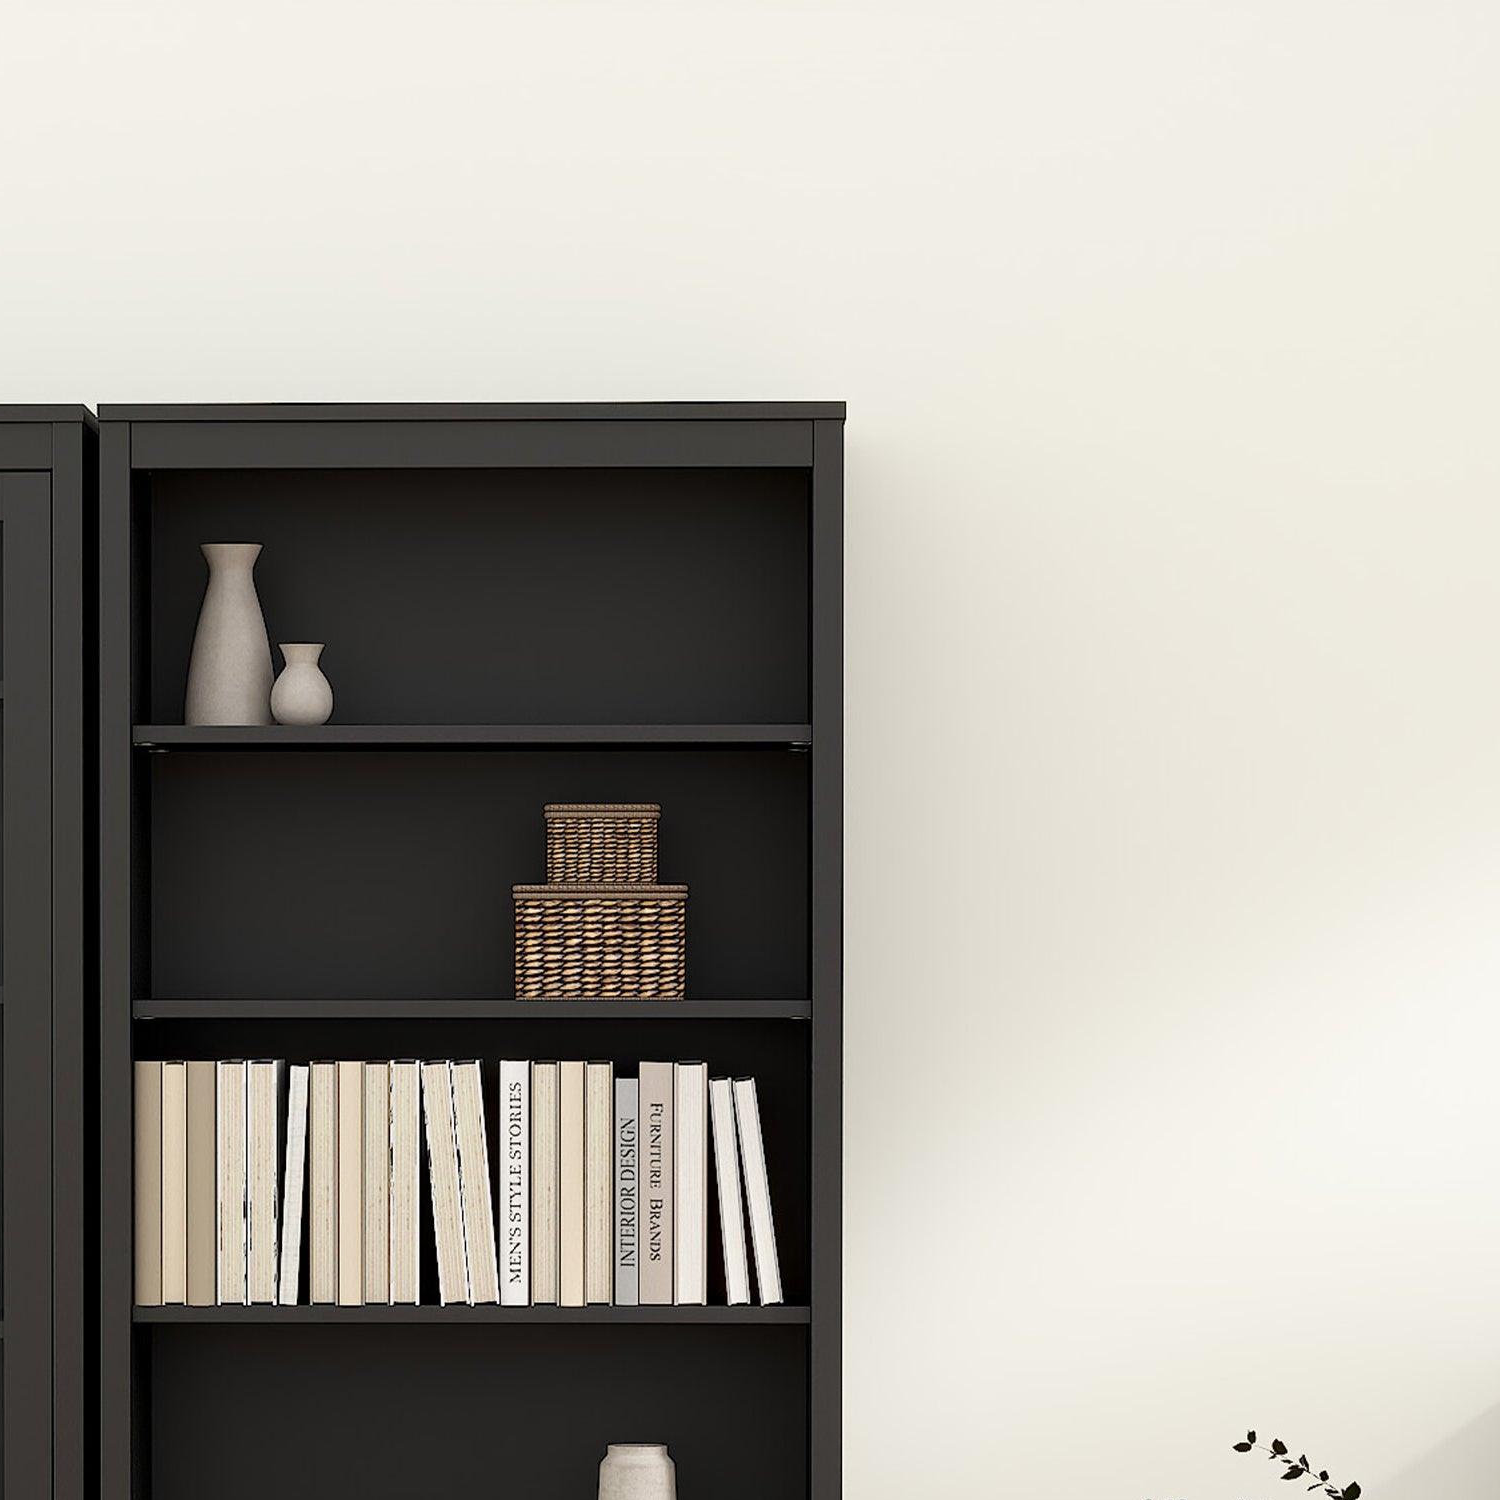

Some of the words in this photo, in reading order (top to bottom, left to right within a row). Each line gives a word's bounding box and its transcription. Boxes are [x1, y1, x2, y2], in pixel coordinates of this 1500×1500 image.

[508, 1082, 522, 1160] STORIES
[620, 1118, 635, 1181] DESIGN
[508, 1165, 522, 1223] STYLE
[508, 1228, 522, 1284] MEN'S
[620, 1186, 635, 1267] INTERIOR
